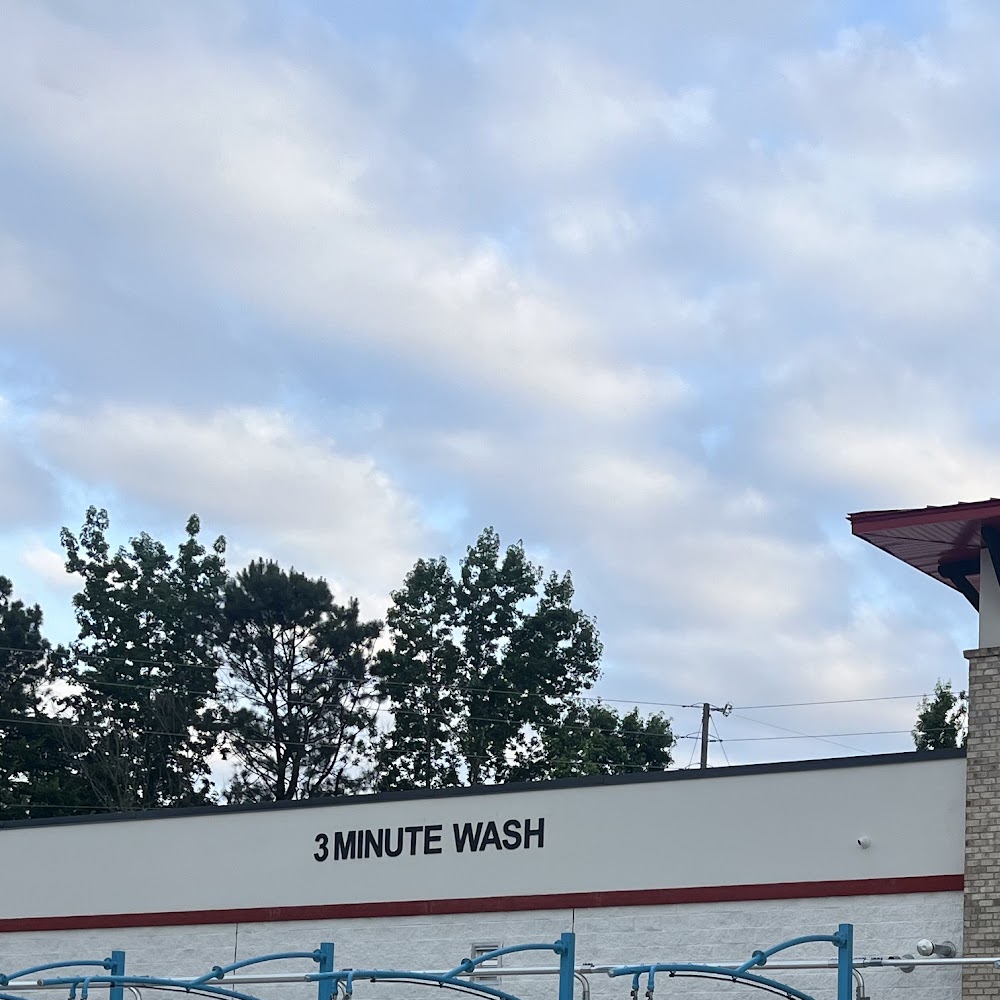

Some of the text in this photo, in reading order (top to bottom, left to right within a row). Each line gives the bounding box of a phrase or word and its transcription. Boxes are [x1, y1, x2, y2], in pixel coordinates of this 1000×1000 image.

[313, 817, 545, 862] 3 MINUTE WASH
